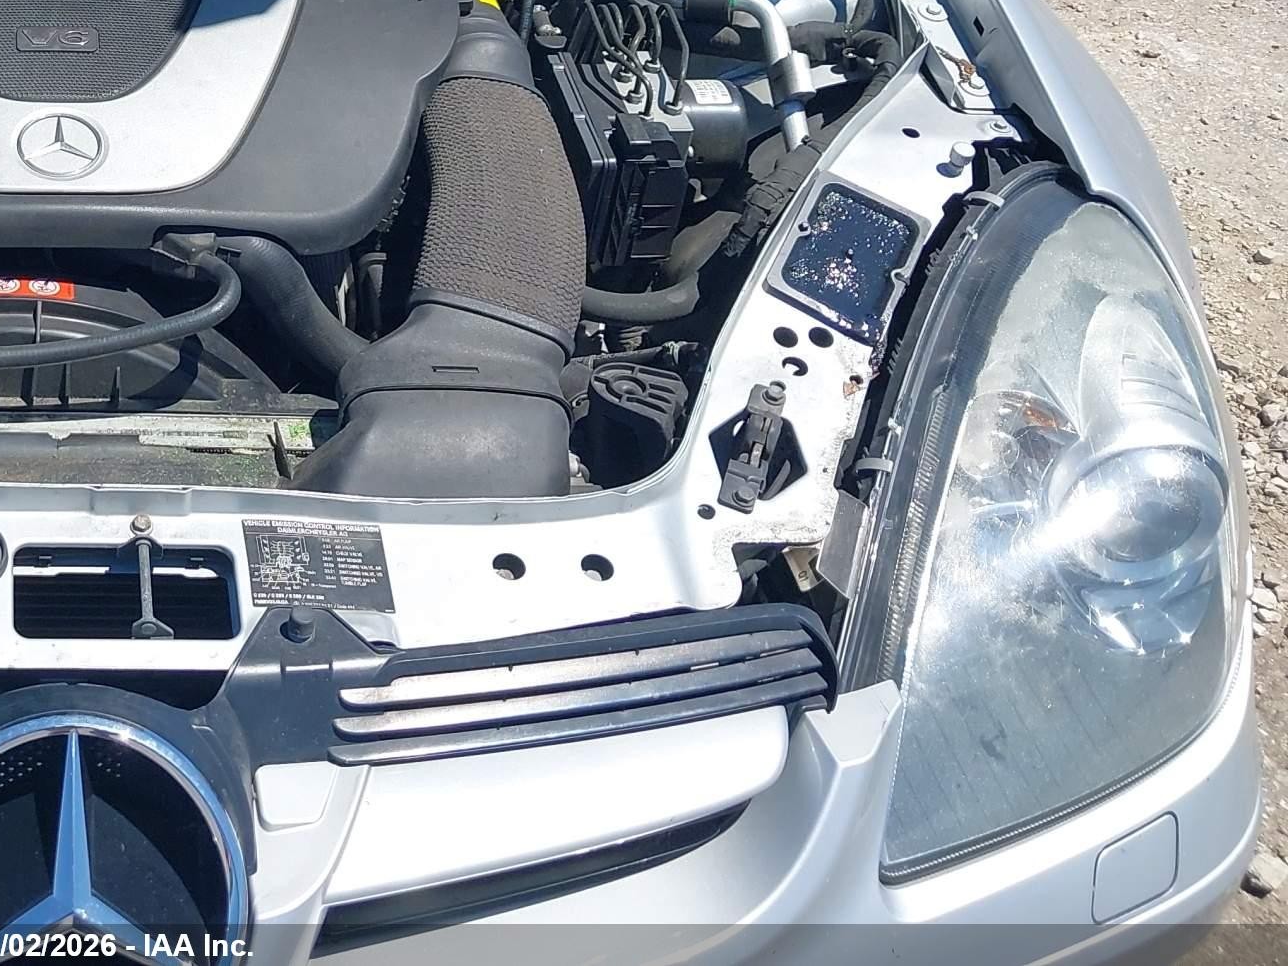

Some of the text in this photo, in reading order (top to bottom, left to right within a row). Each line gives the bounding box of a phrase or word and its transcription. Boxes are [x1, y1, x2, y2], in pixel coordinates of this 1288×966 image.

[22, 29, 89, 46] V6
[277, 528, 337, 536] DAIMLERCHRYSLER
[304, 522, 334, 530] CONTROL
[335, 524, 379, 533] INFORMATION
